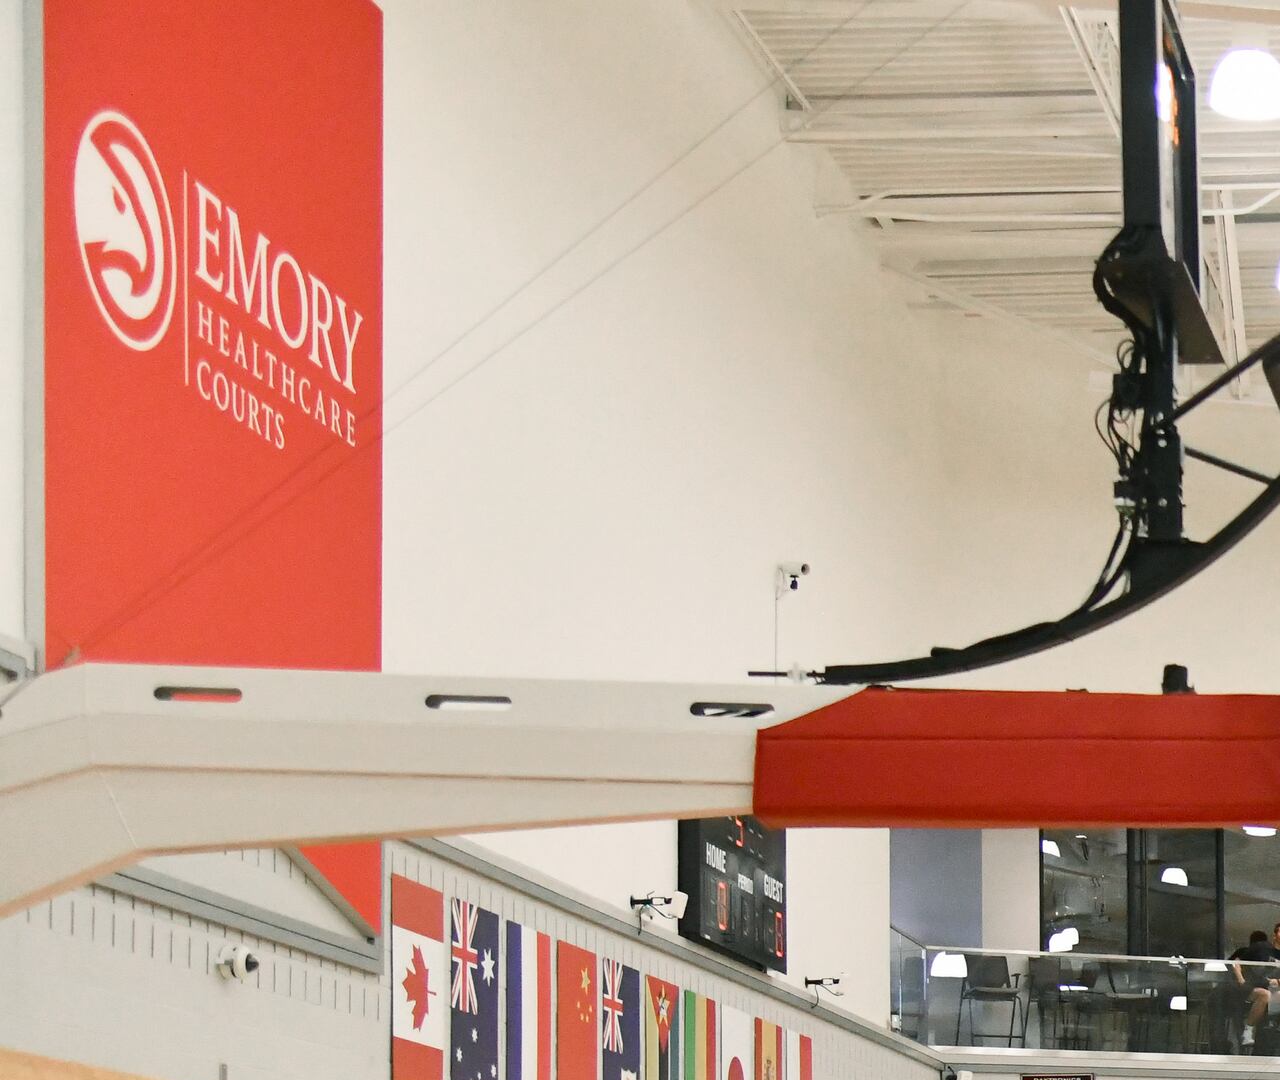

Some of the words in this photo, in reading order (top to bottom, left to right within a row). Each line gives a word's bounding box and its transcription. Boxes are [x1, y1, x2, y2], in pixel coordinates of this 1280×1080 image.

[195, 182, 363, 394] EMORY
[196, 361, 285, 450] COURTS
[198, 301, 356, 447] HEALTHCARE
[705, 842, 726, 873] HOME
[764, 873, 783, 903] GUEST
